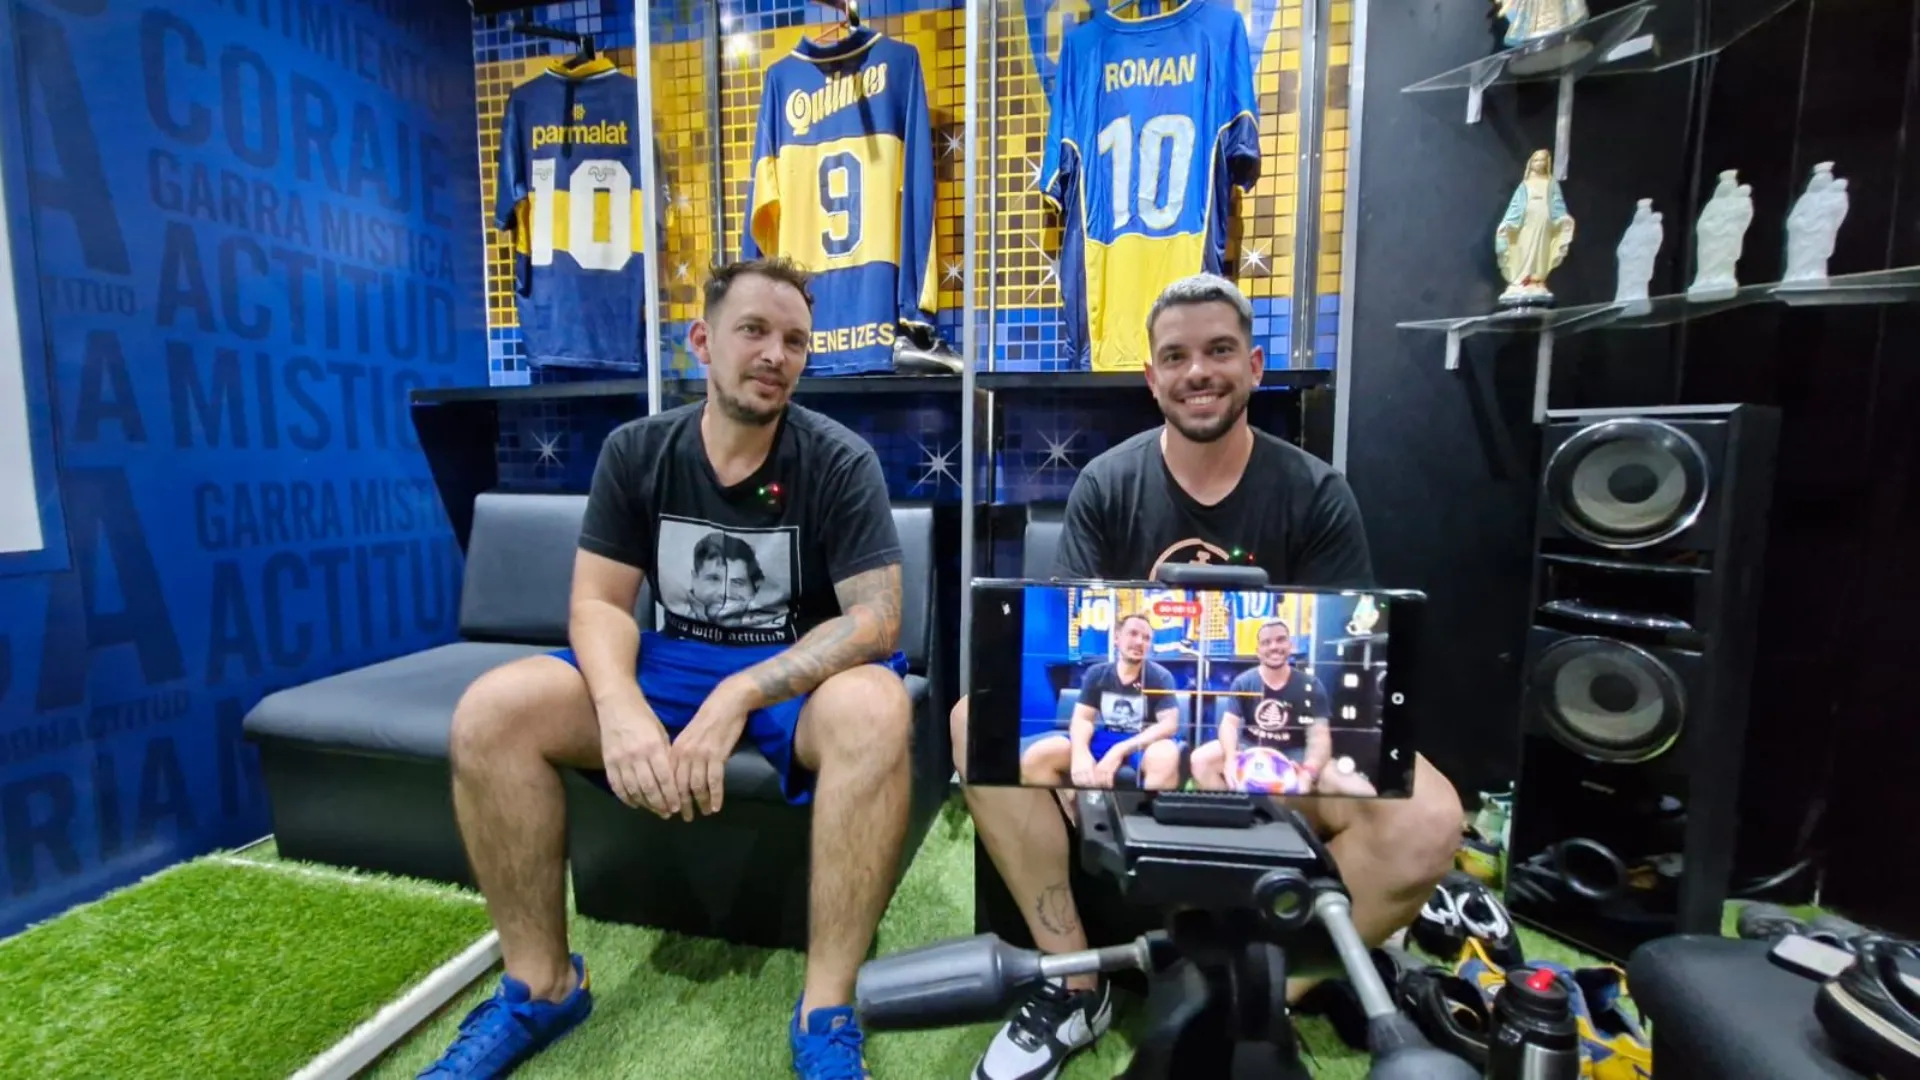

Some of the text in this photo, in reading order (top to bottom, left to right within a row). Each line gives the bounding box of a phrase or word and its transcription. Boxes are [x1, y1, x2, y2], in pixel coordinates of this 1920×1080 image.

[140, 8, 453, 229] CORAJE
[785, 62, 888, 137] Quilmes
[1103, 53, 1197, 93] ROMAN
[532, 119, 628, 150] parmalat
[1097, 113, 1196, 230] 10
[148, 147, 457, 285] GARRA MISTICA
[530, 158, 632, 271] 10
[818, 150, 866, 259] 9
[155, 220, 459, 365] ACTITUD
[166, 338, 455, 450] MISTIC
[193, 478, 344, 552] GARRA
